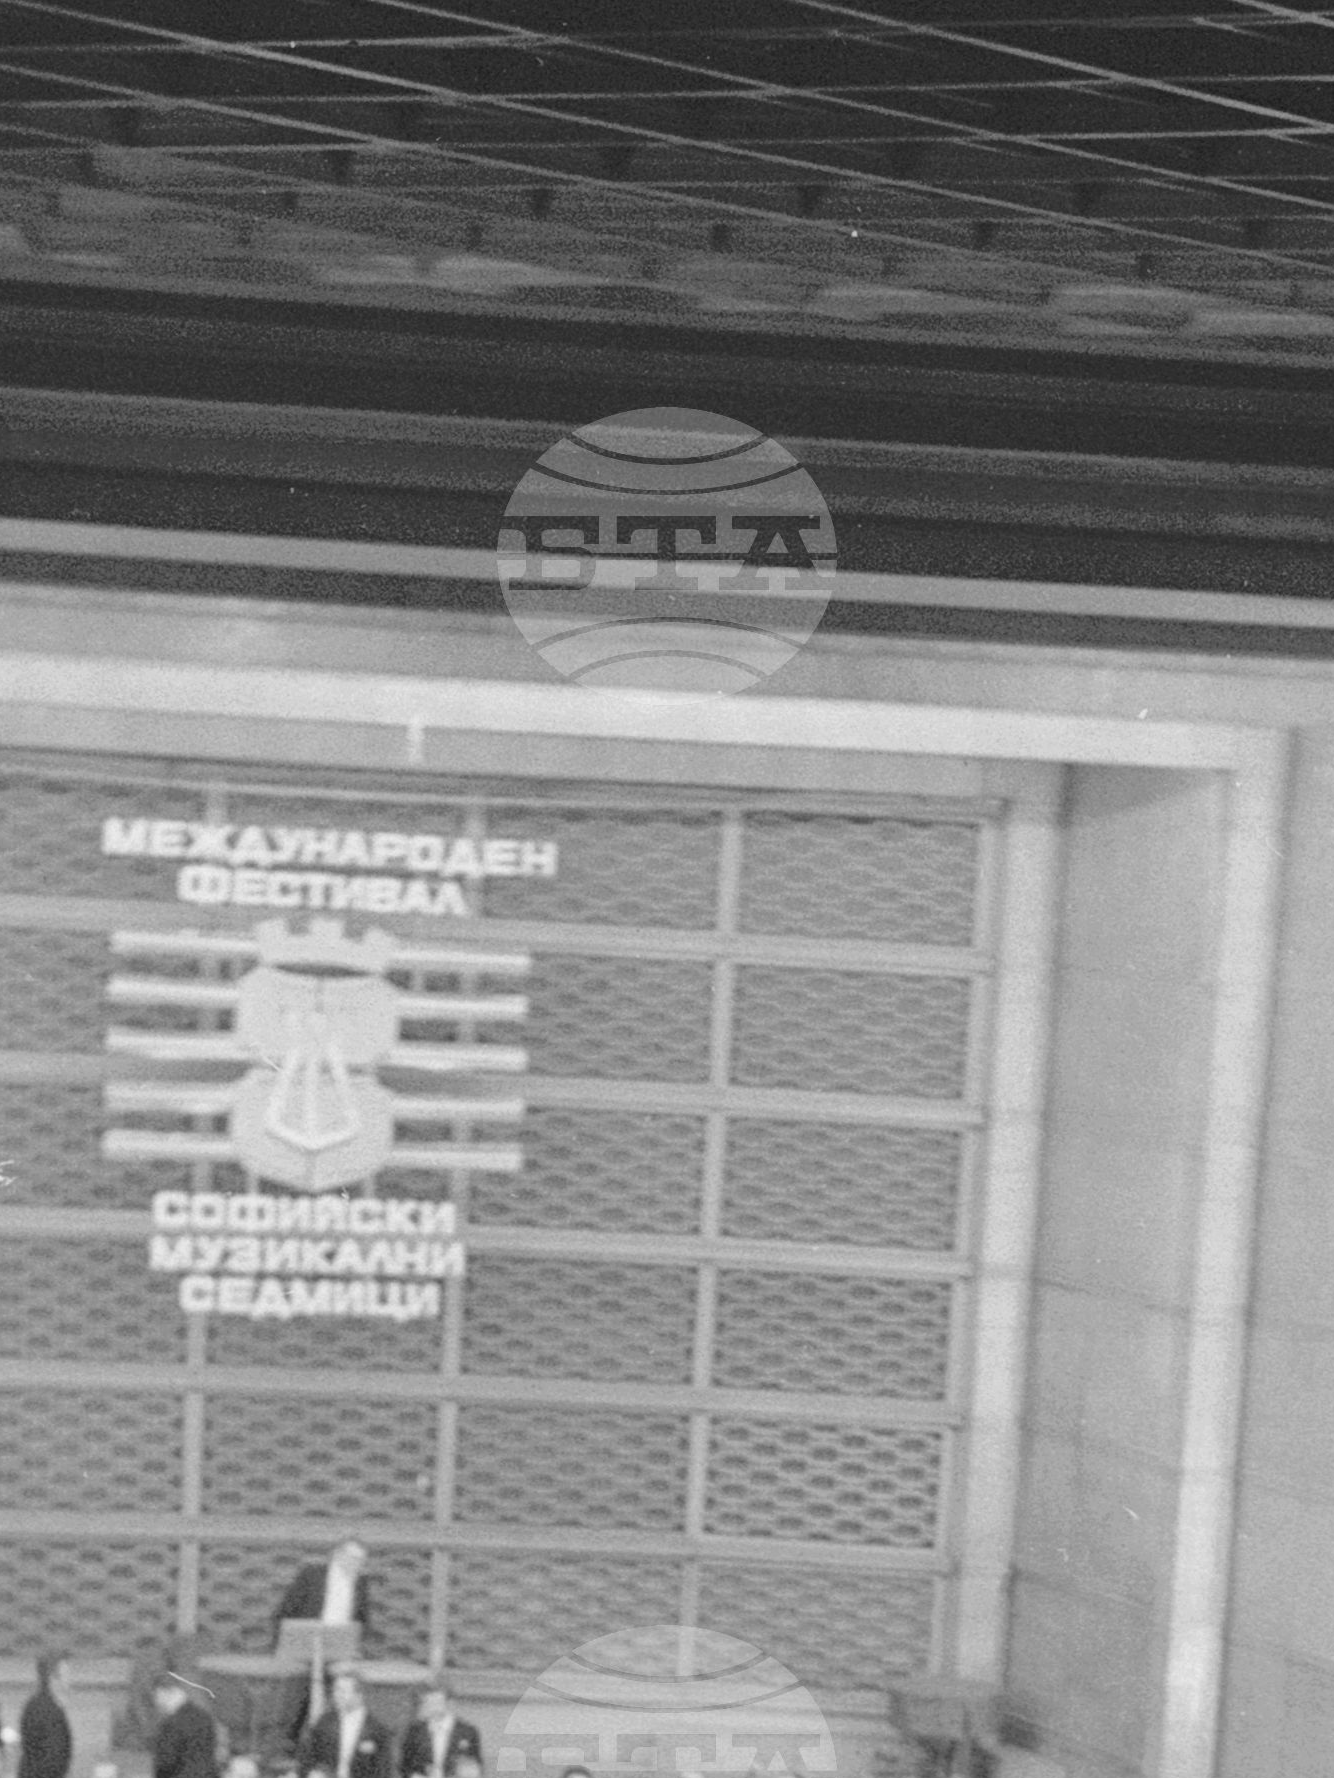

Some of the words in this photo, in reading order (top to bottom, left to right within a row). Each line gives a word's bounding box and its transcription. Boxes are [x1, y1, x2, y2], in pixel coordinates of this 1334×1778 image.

[102, 817, 560, 878] МЕЖДУНАРОДЕН
[177, 864, 469, 916] ФЕСТИВАЛ
[148, 1234, 466, 1278] МУЗИКАЛНИ
[179, 1275, 440, 1322] СЕДМИЦИ
